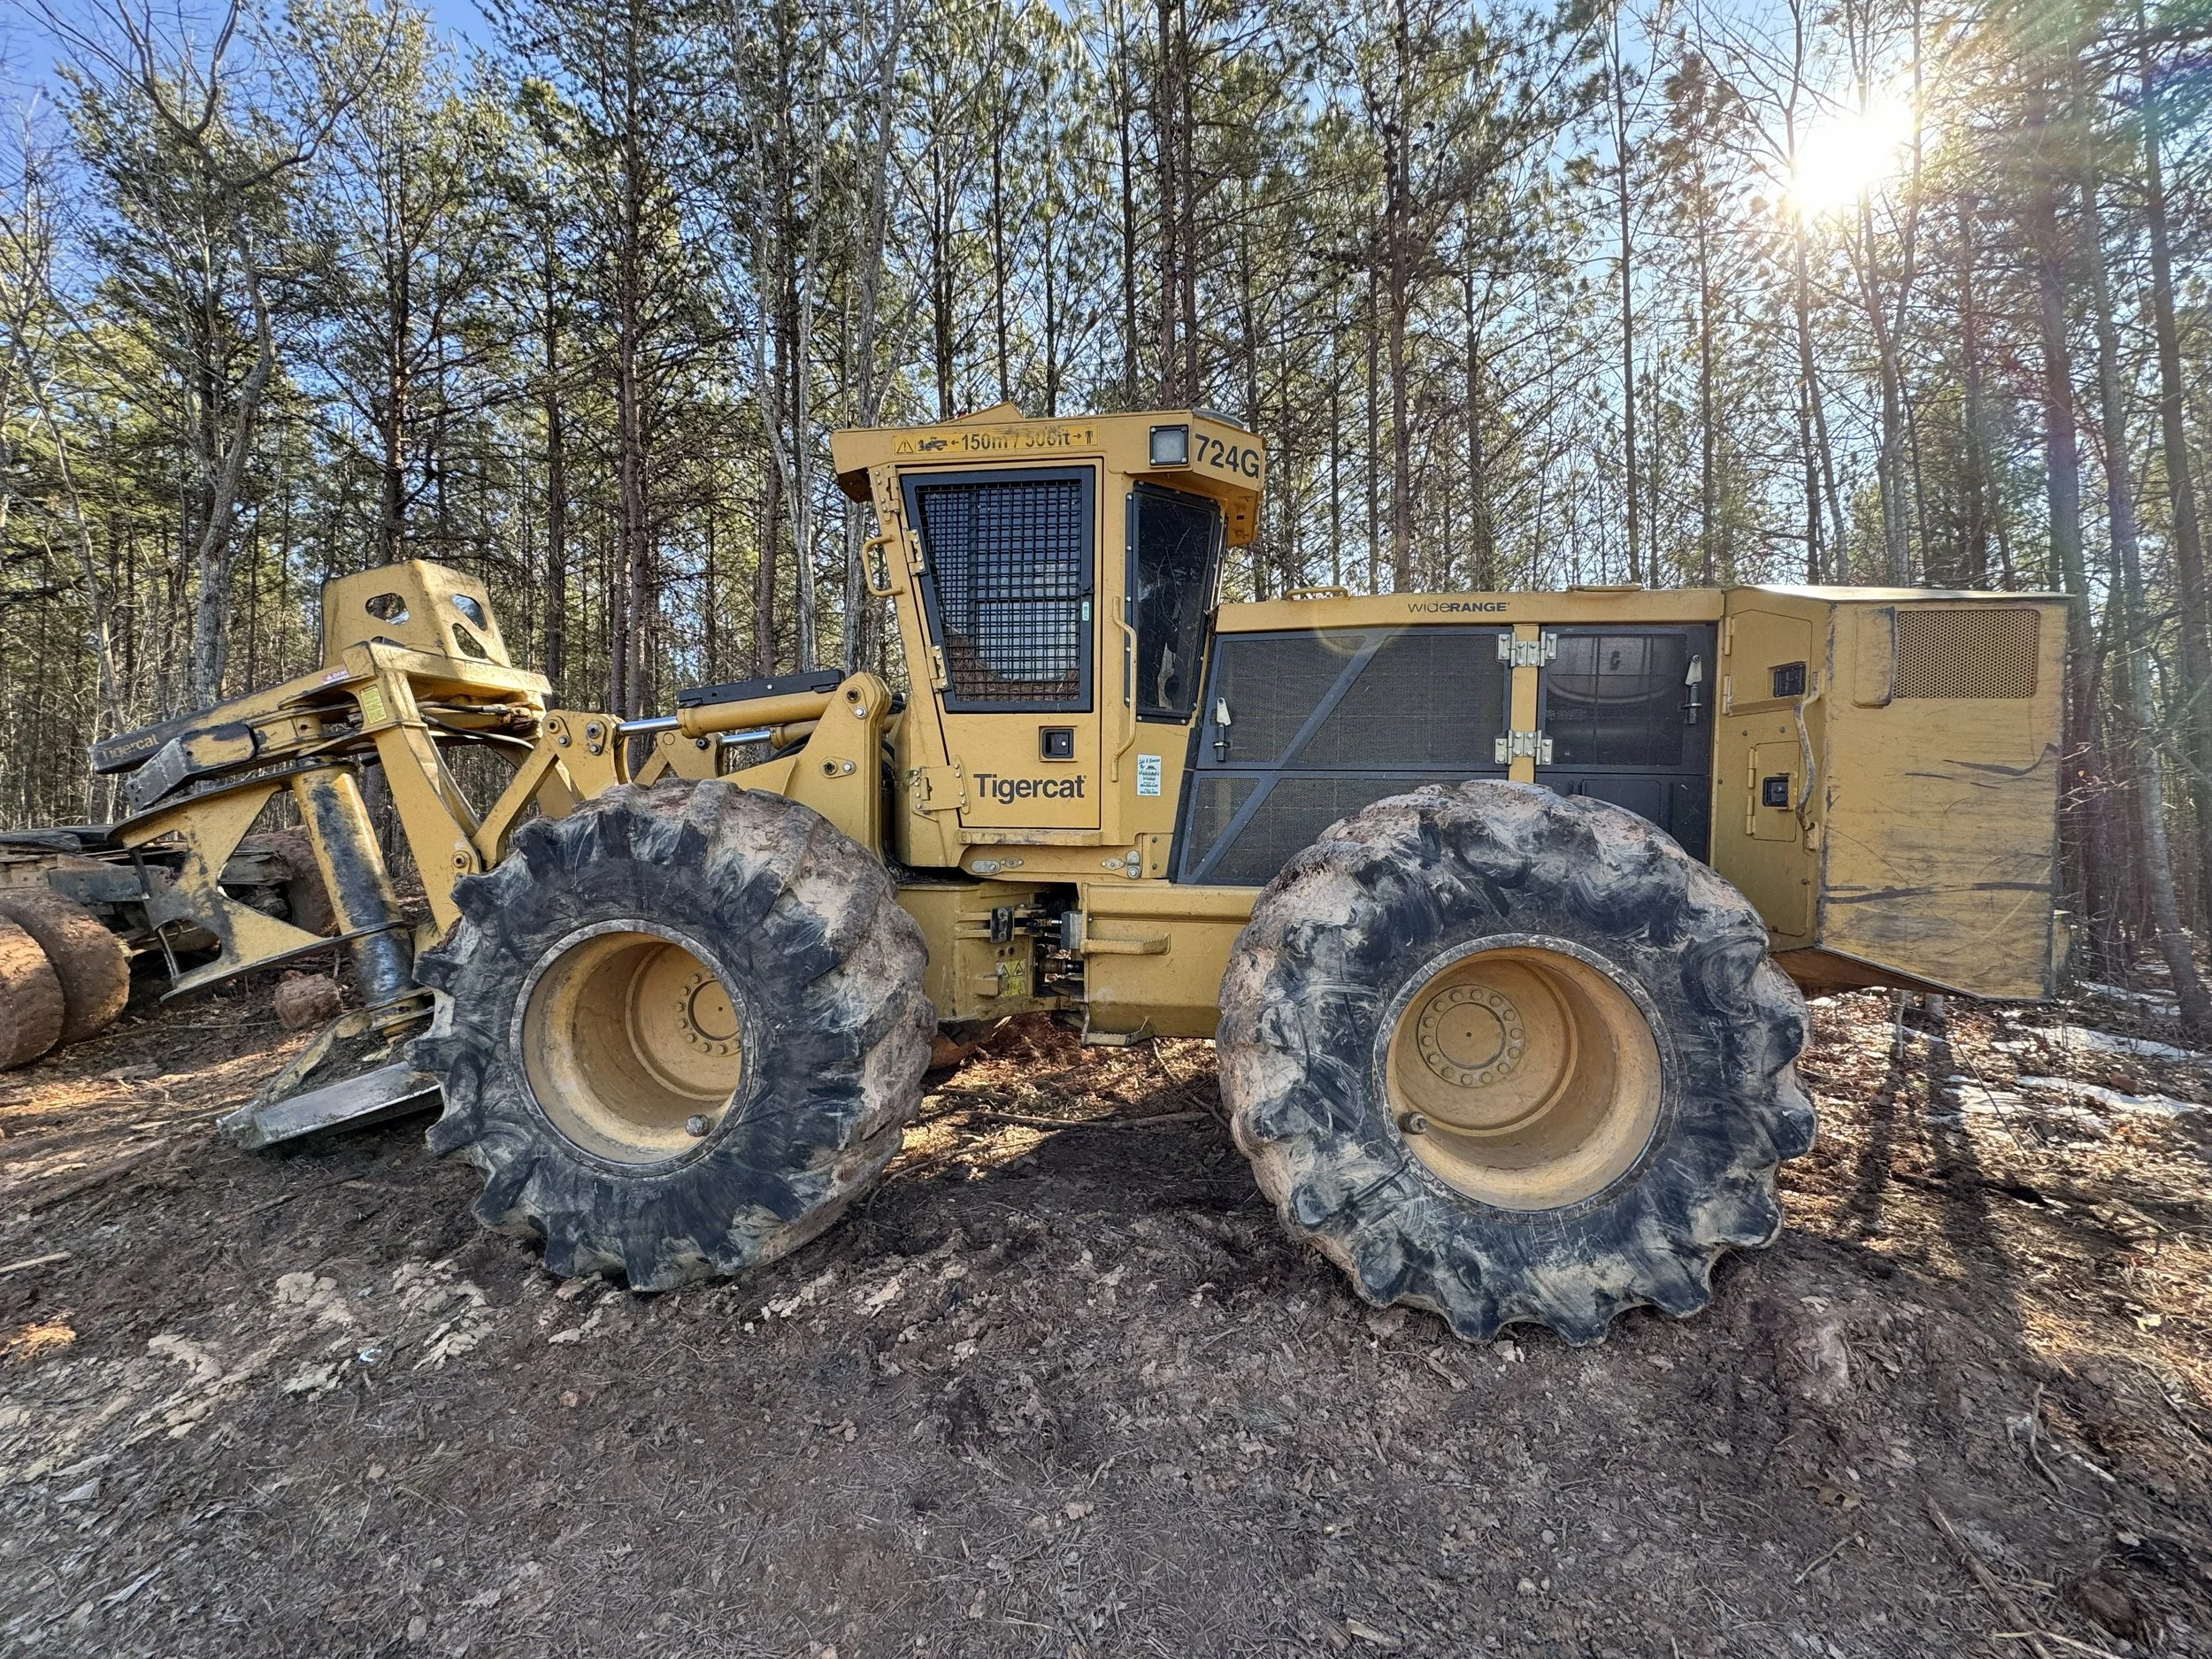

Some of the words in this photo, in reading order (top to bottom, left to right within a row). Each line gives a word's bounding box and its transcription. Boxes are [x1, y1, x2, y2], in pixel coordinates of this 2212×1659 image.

[962, 433, 1007, 450] 150m
[1194, 433, 1260, 480] 724G
[972, 773, 1086, 804] Tigercat
